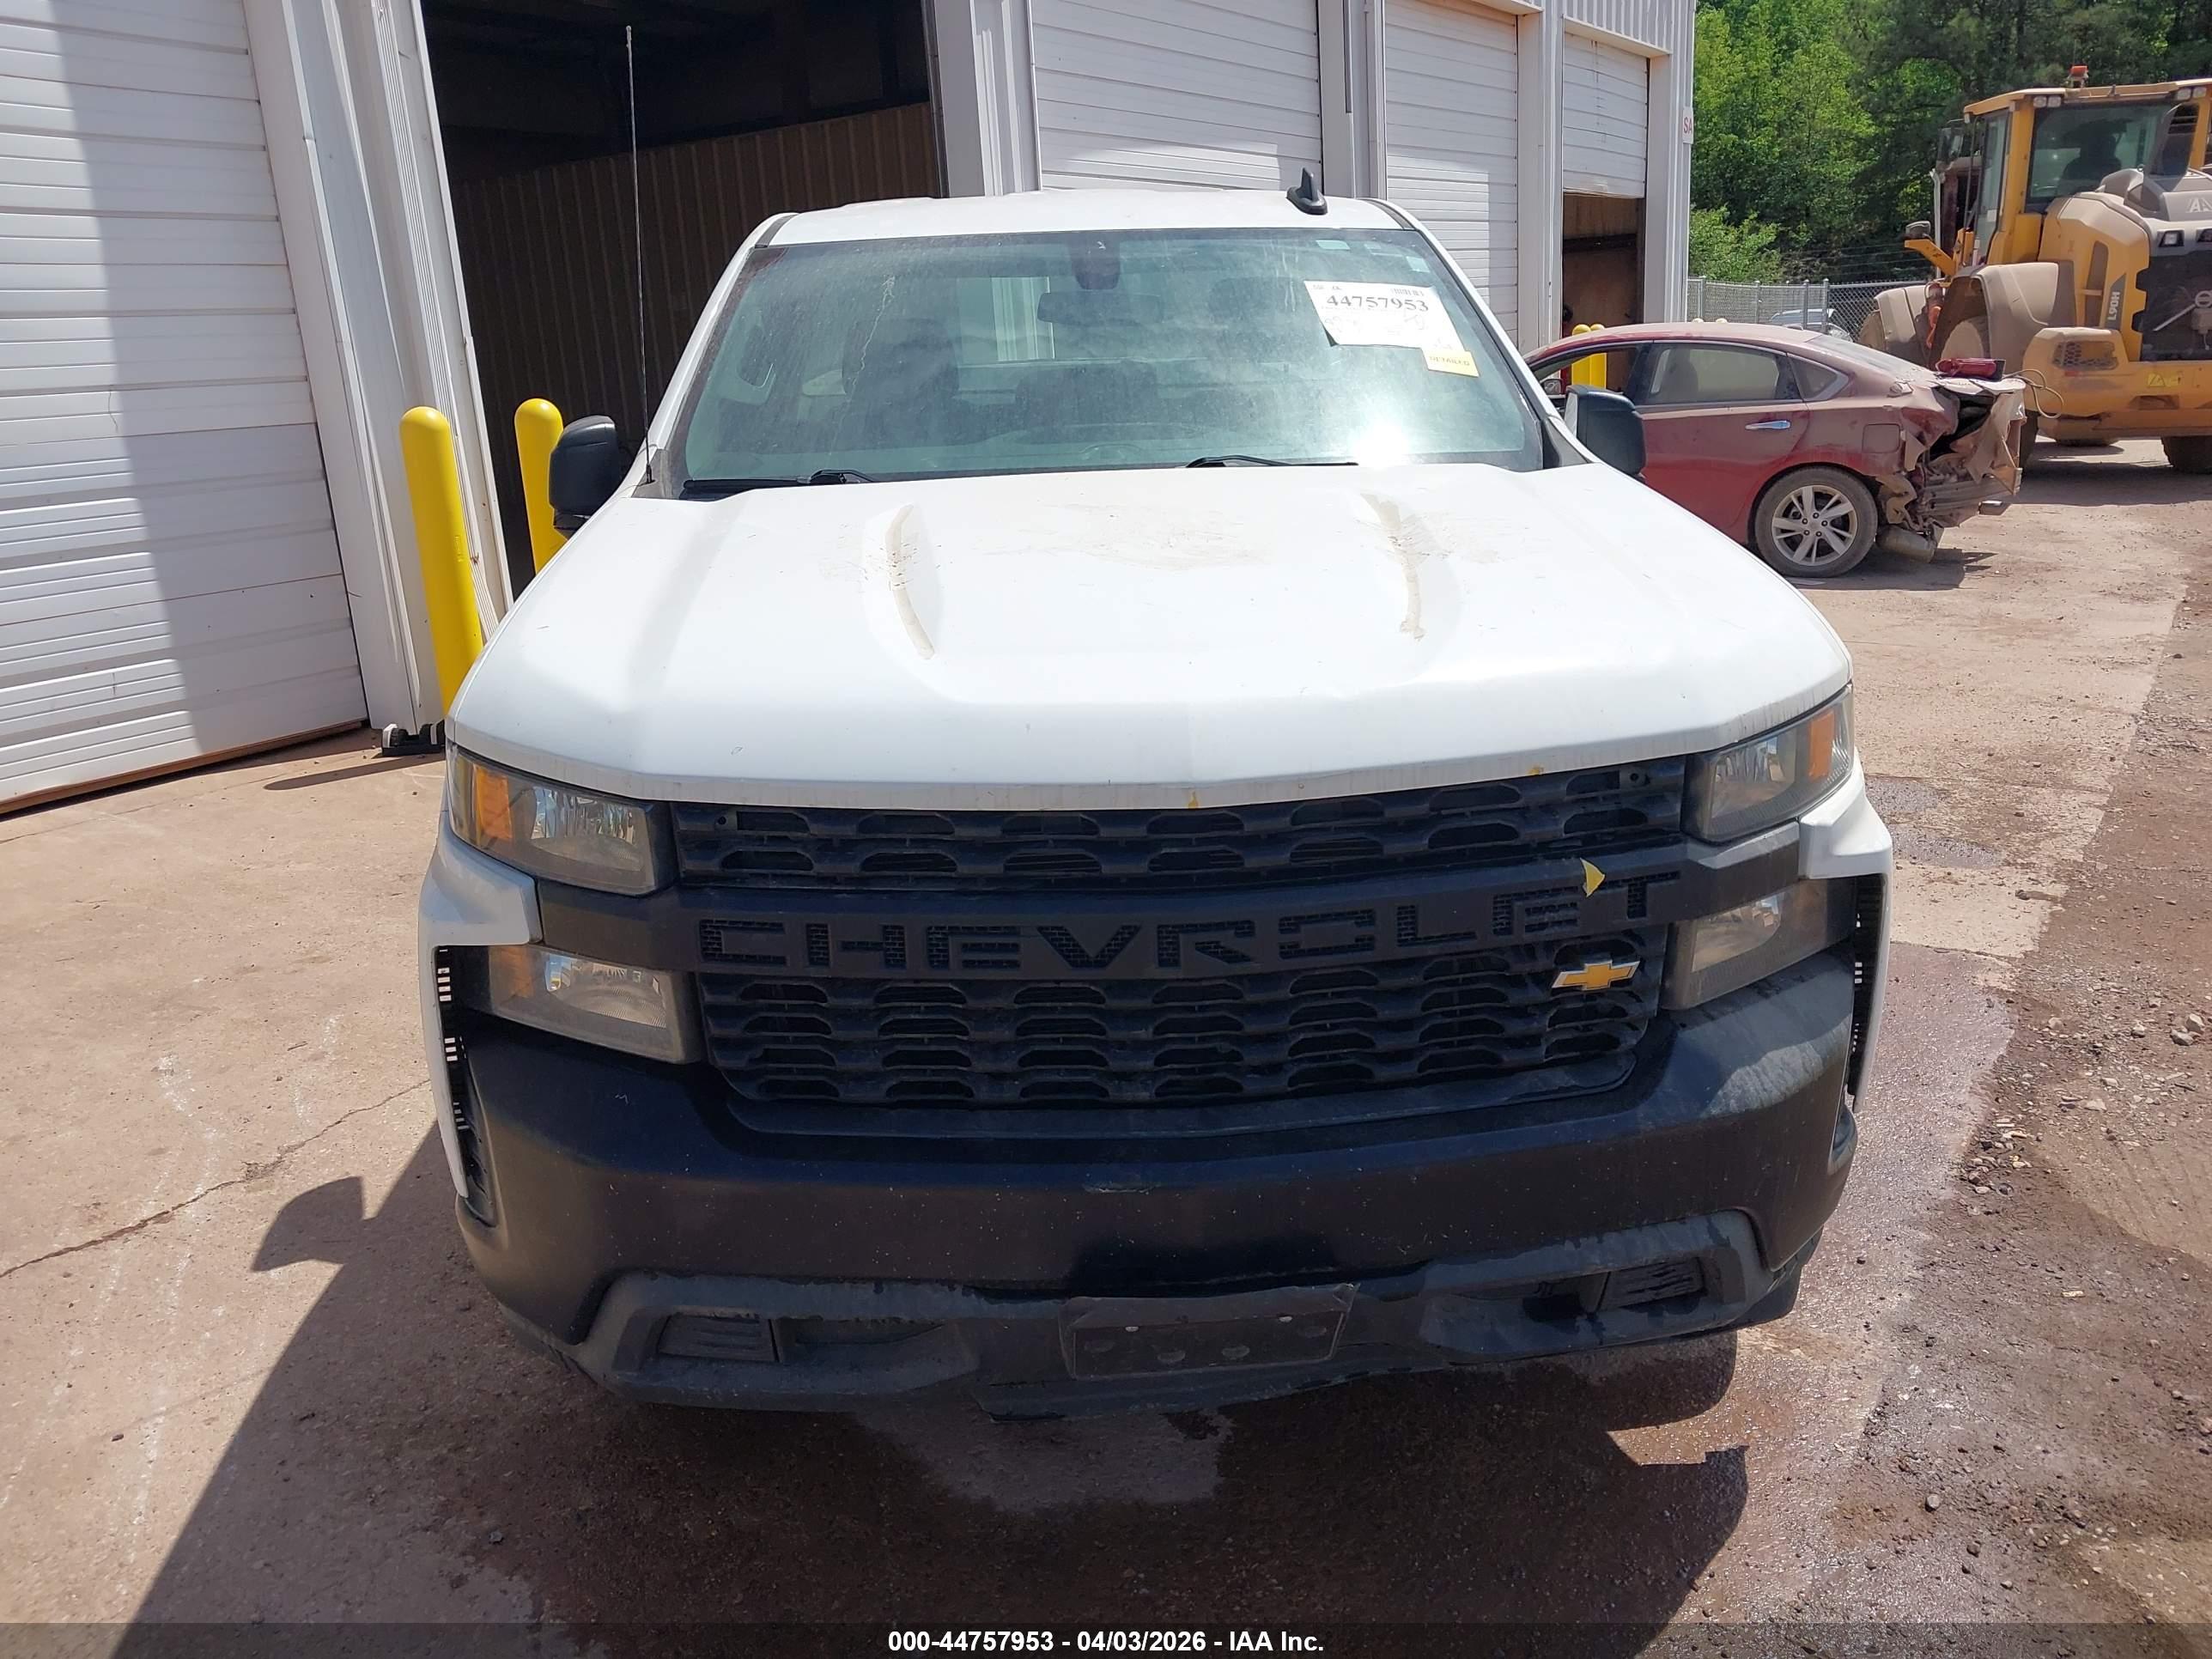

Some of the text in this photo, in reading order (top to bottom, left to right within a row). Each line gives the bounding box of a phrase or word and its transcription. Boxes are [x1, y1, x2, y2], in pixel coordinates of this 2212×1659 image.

[1327, 295, 1430, 313] 44757953
[2108, 291, 2120, 320] L90H
[699, 870, 1680, 970] CHEVROLET
